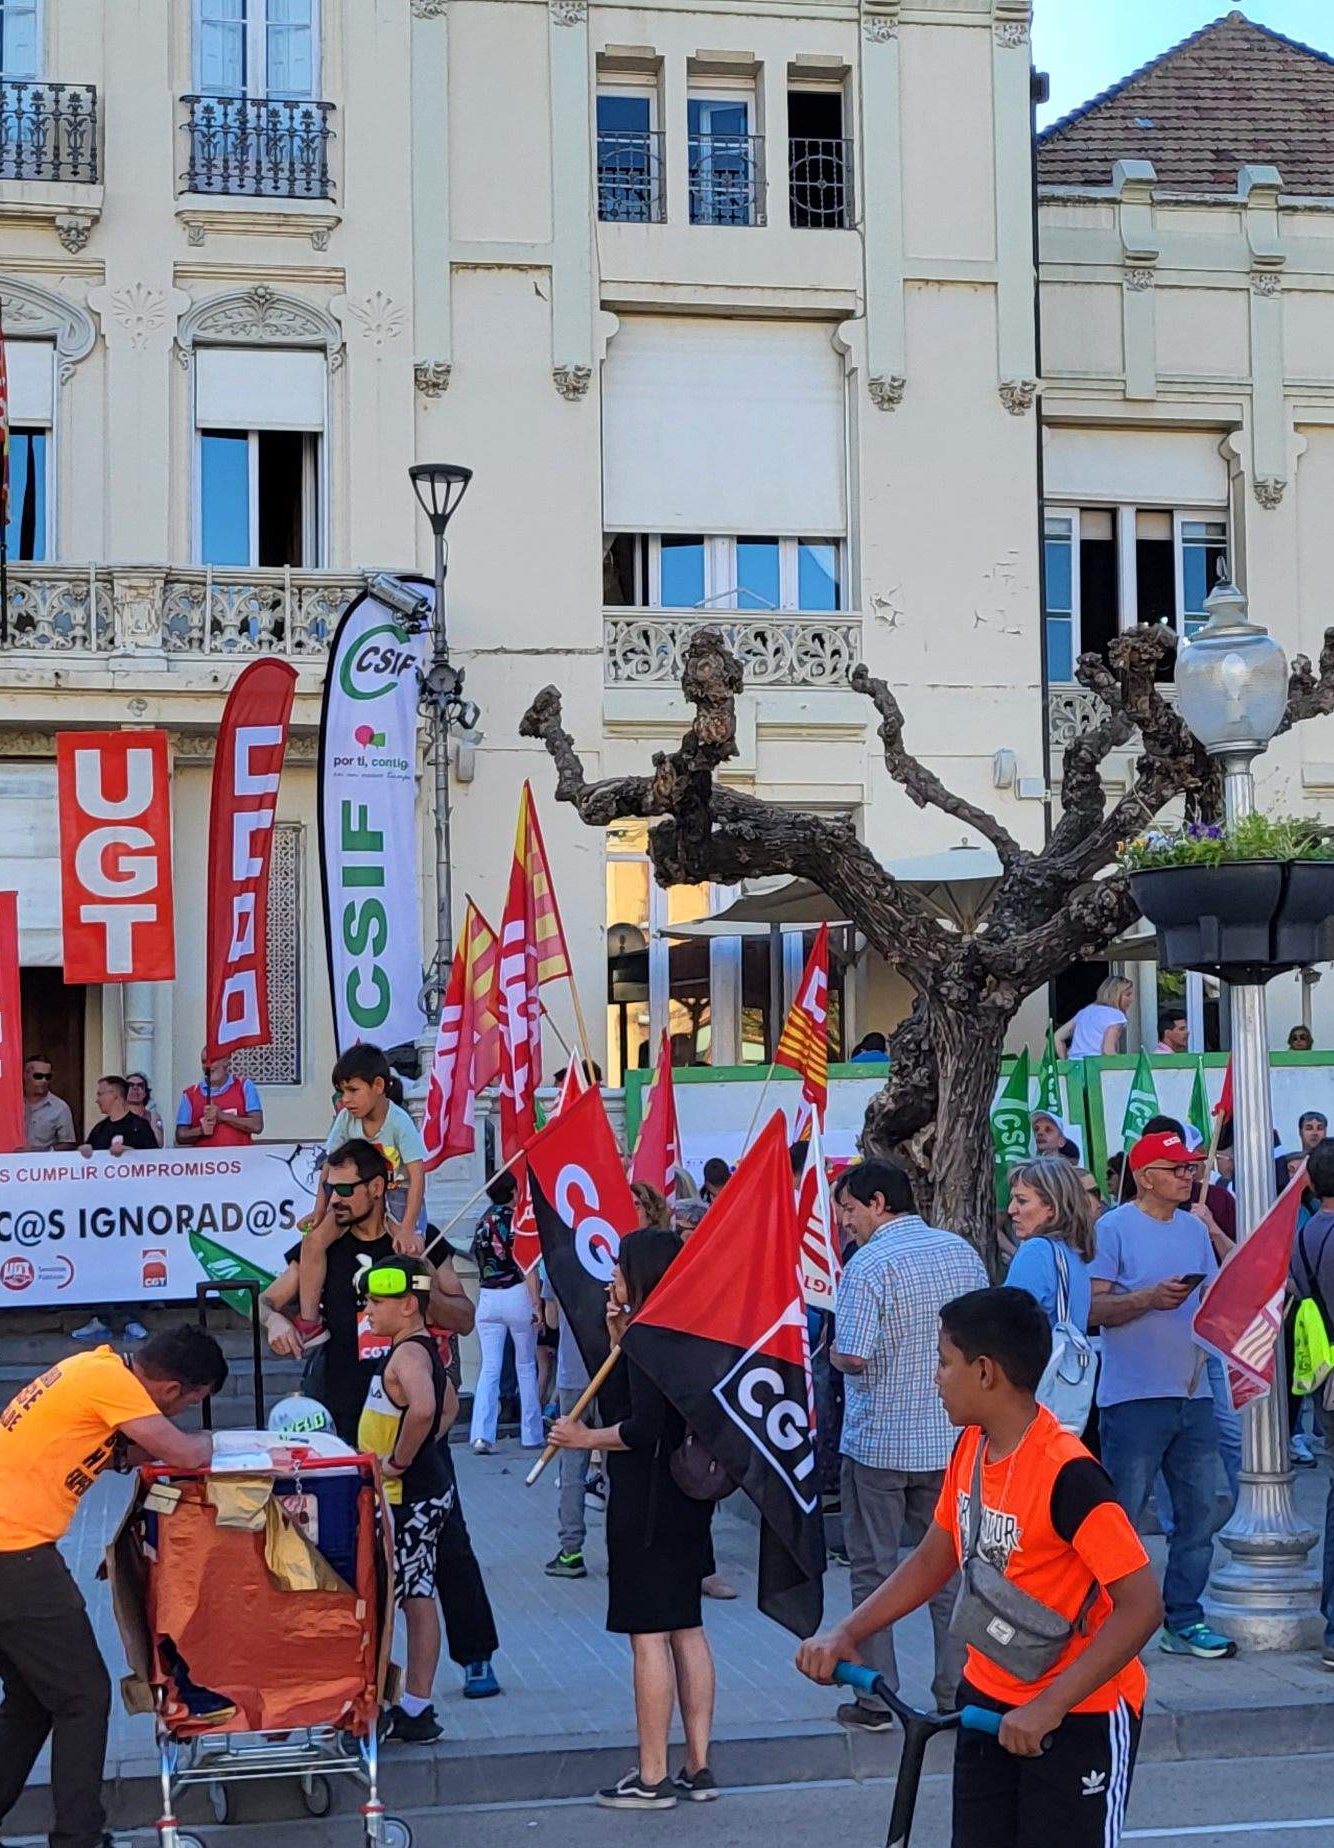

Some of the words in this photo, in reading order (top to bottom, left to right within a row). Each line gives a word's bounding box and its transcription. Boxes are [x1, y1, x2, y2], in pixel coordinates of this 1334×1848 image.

[356, 646, 417, 678] CSIF
[334, 756, 355, 768] por
[74, 748, 158, 976] UGT
[341, 799, 393, 1031] CSIF
[17, 1166, 98, 1183] CUMPLIR
[104, 1160, 242, 1179] COMPROMISOS
[79, 1199, 297, 1239] IGNORAD@S
[555, 1163, 621, 1282] CG
[144, 1277, 166, 1288] CGT
[362, 1346, 391, 1360] CGT
